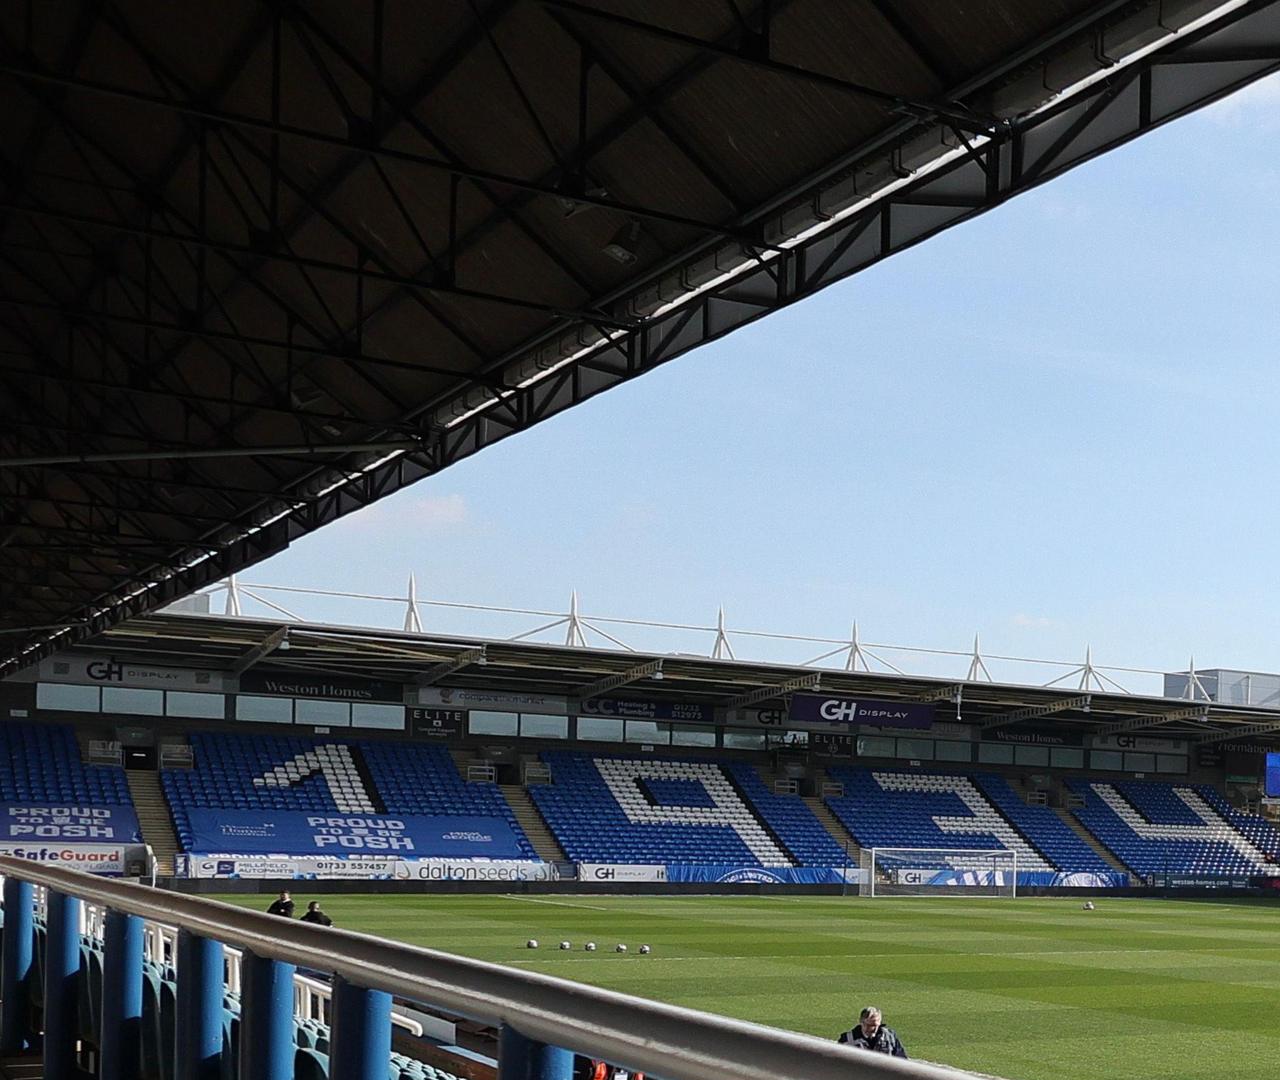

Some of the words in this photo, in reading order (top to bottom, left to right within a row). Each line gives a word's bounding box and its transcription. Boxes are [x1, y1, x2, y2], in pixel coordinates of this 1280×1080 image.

[265, 680, 322, 695] Weston
[322, 684, 372, 698] Homes
[413, 709, 462, 721] ELITE
[820, 699, 857, 722] GH
[859, 709, 909, 719] DISPLAY
[815, 736, 852, 744] ELITE
[996, 731, 1030, 742] Weston
[1030, 733, 1063, 743] Homes
[9, 807, 112, 818] PROUD
[17, 816, 44, 824] TO
[79, 818, 106, 826] BE
[307, 817, 406, 830] PROUD
[10, 824, 114, 838] POSH
[317, 827, 343, 835] TO
[378, 830, 403, 838] BE
[314, 835, 415, 850] POSH
[13, 848, 119, 861] SafeGuard
[594, 867, 615, 879] GH
[904, 873, 921, 883] GH
